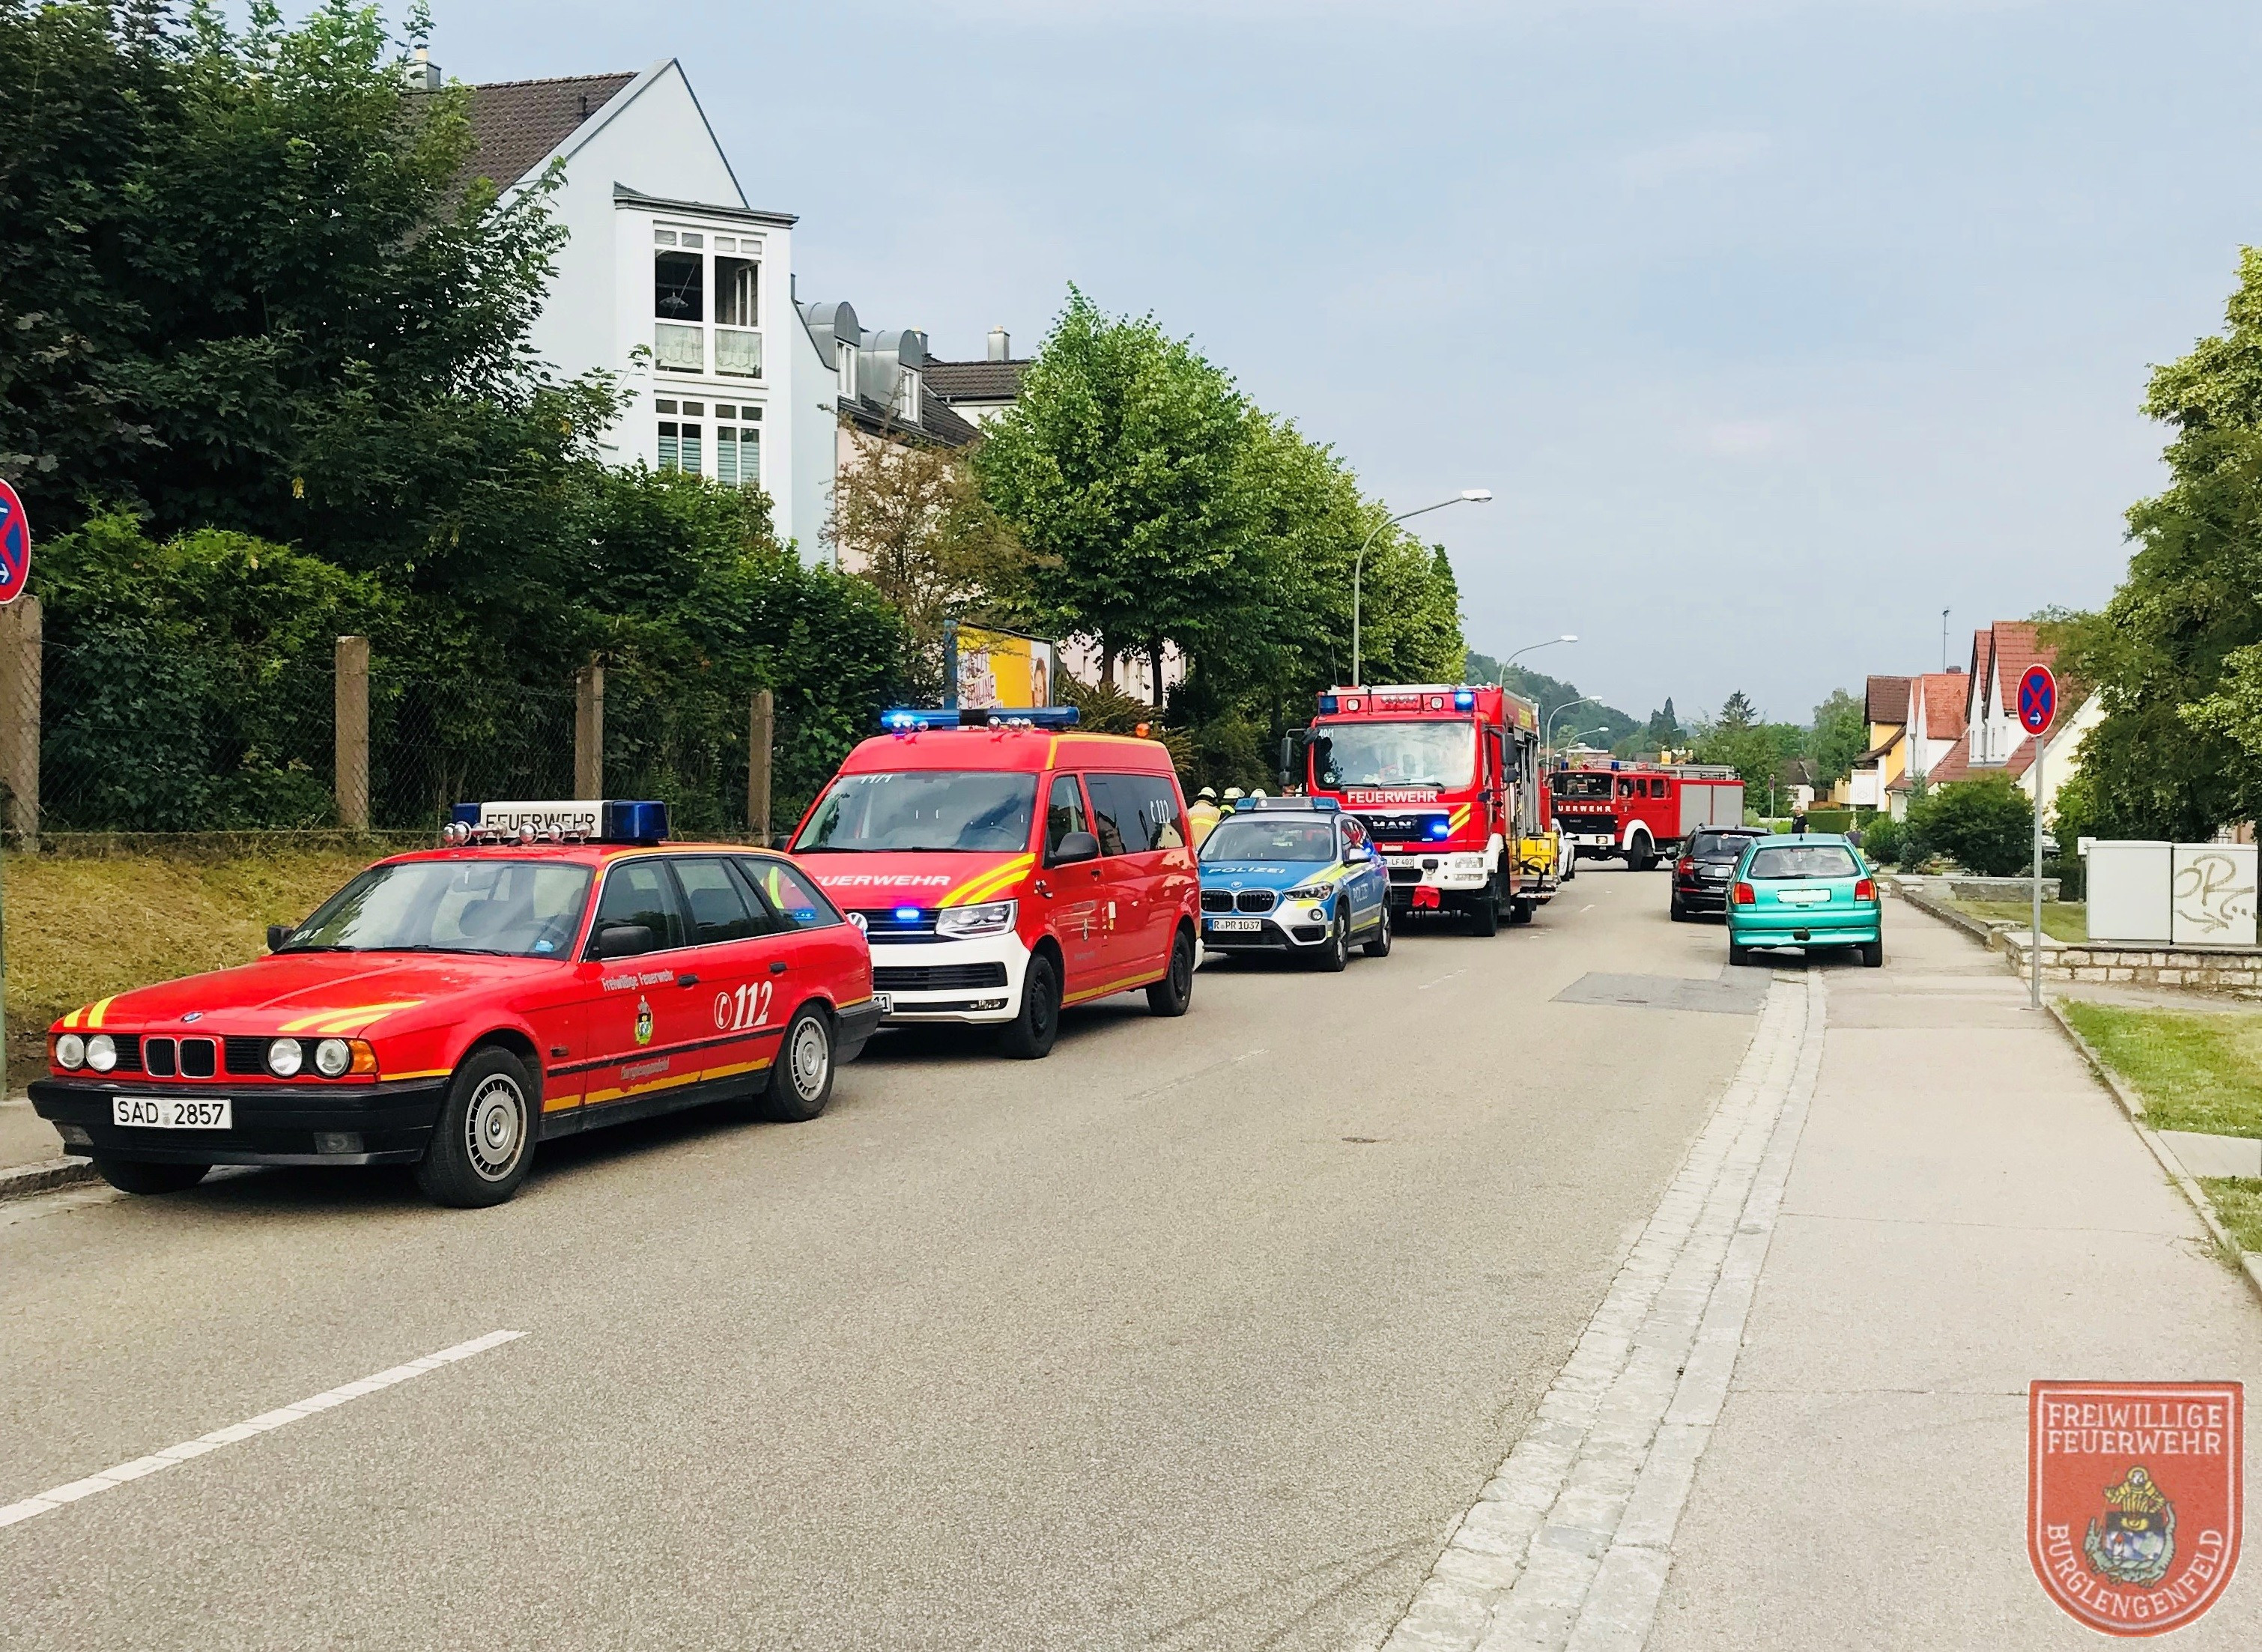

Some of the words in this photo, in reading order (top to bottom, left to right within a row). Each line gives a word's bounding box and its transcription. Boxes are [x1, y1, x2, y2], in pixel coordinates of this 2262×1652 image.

[861, 774, 894, 784] 11/1
[1347, 791, 1437, 803] FEUERWEHR
[1373, 821, 1411, 829] MAN
[815, 875, 951, 886] UERWEHR
[1214, 921, 1219, 929] R
[1225, 921, 1237, 929] PR
[1238, 921, 1260, 929] 1037
[730, 980, 773, 1031] 112
[118, 1101, 158, 1123] SAD
[174, 1103, 224, 1125] 2857
